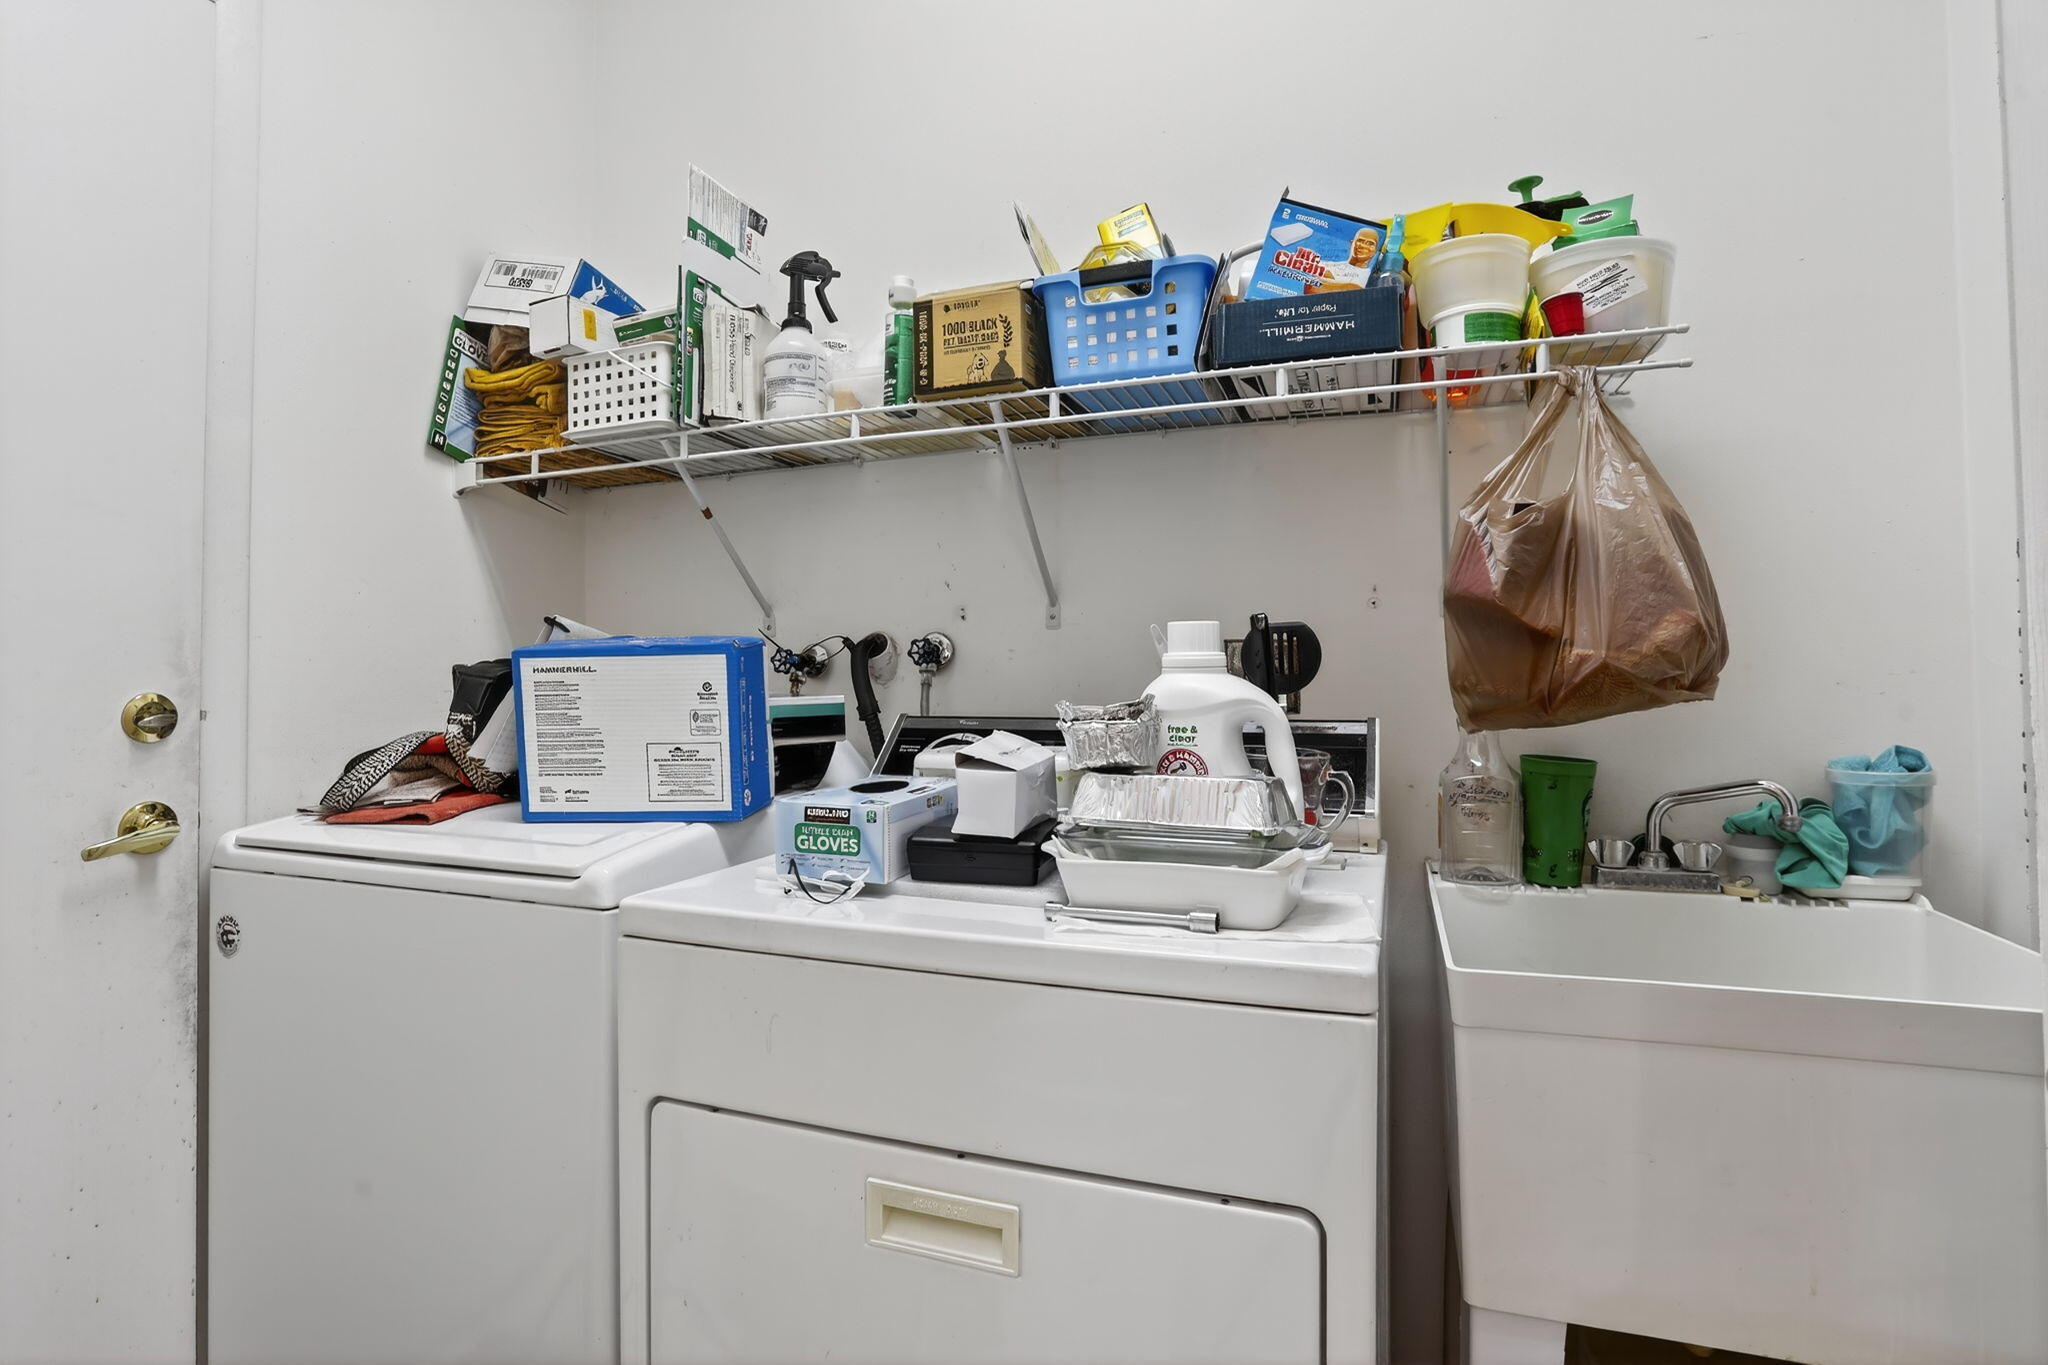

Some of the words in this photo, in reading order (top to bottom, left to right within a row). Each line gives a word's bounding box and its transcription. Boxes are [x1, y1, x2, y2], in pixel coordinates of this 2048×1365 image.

[1273, 250, 1327, 278] Clean
[942, 321, 966, 336] 1000
[1263, 320, 1355, 337] HAMMERMILL
[1167, 724, 1188, 733] free
[1190, 725, 1198, 733] &
[1169, 734, 1196, 743] clear
[796, 834, 859, 853] GLOVES
